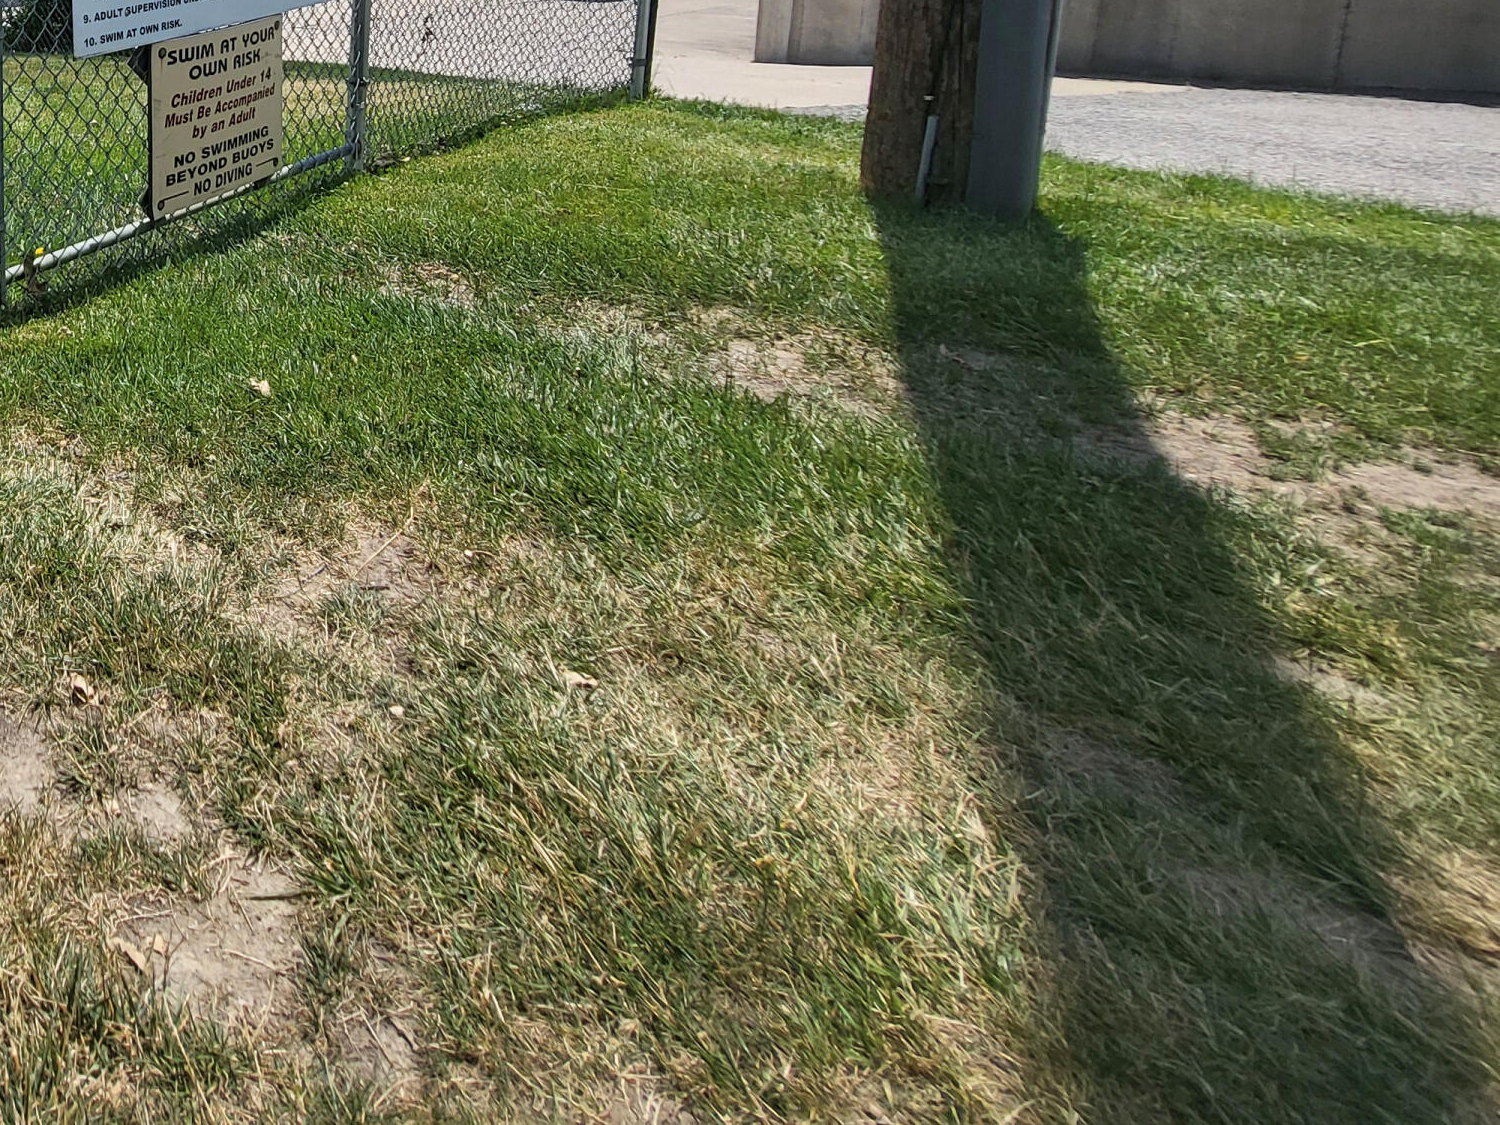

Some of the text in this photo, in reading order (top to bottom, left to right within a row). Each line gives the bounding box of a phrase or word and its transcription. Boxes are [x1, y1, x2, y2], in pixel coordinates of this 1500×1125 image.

[84, 15, 91, 24] 9.
[94, 9, 122, 22] ADULT
[84, 19, 182, 47] 10. SWIM AT OWN RISK.
[167, 28, 274, 65] SWIM AT YOUR
[189, 49, 261, 79] OWN RISK
[172, 67, 271, 108] Children Under 14
[165, 83, 275, 128] Must Be Accompanied
[192, 106, 255, 139] by an Adult
[166, 139, 274, 186] BEYOND BUOYS
[174, 126, 268, 168] NO SWIMMING
[194, 163, 252, 195] NO DIVING
